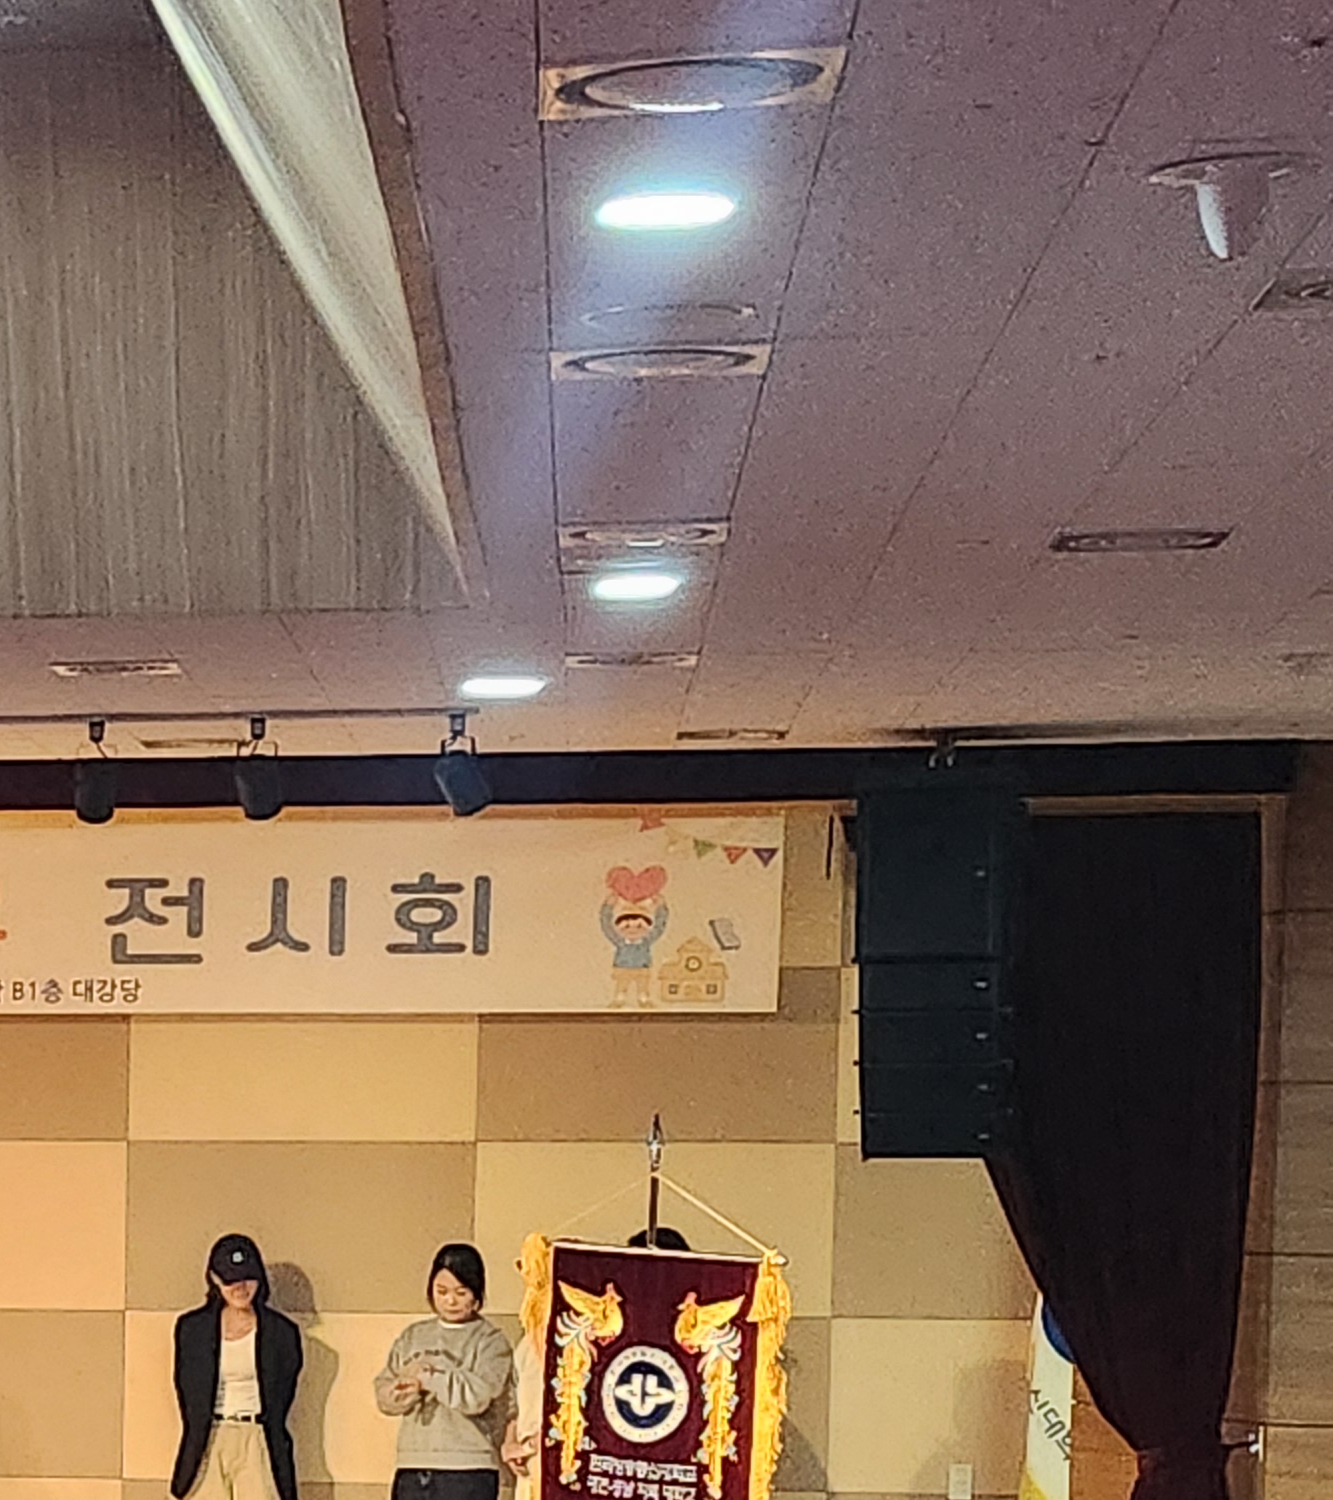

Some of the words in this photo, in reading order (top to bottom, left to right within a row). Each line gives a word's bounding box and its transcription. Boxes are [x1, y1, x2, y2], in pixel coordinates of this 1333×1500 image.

[103, 872, 491, 966] 전시회
[12, 979, 65, 1004] B1층
[72, 979, 143, 1004] 대강당
